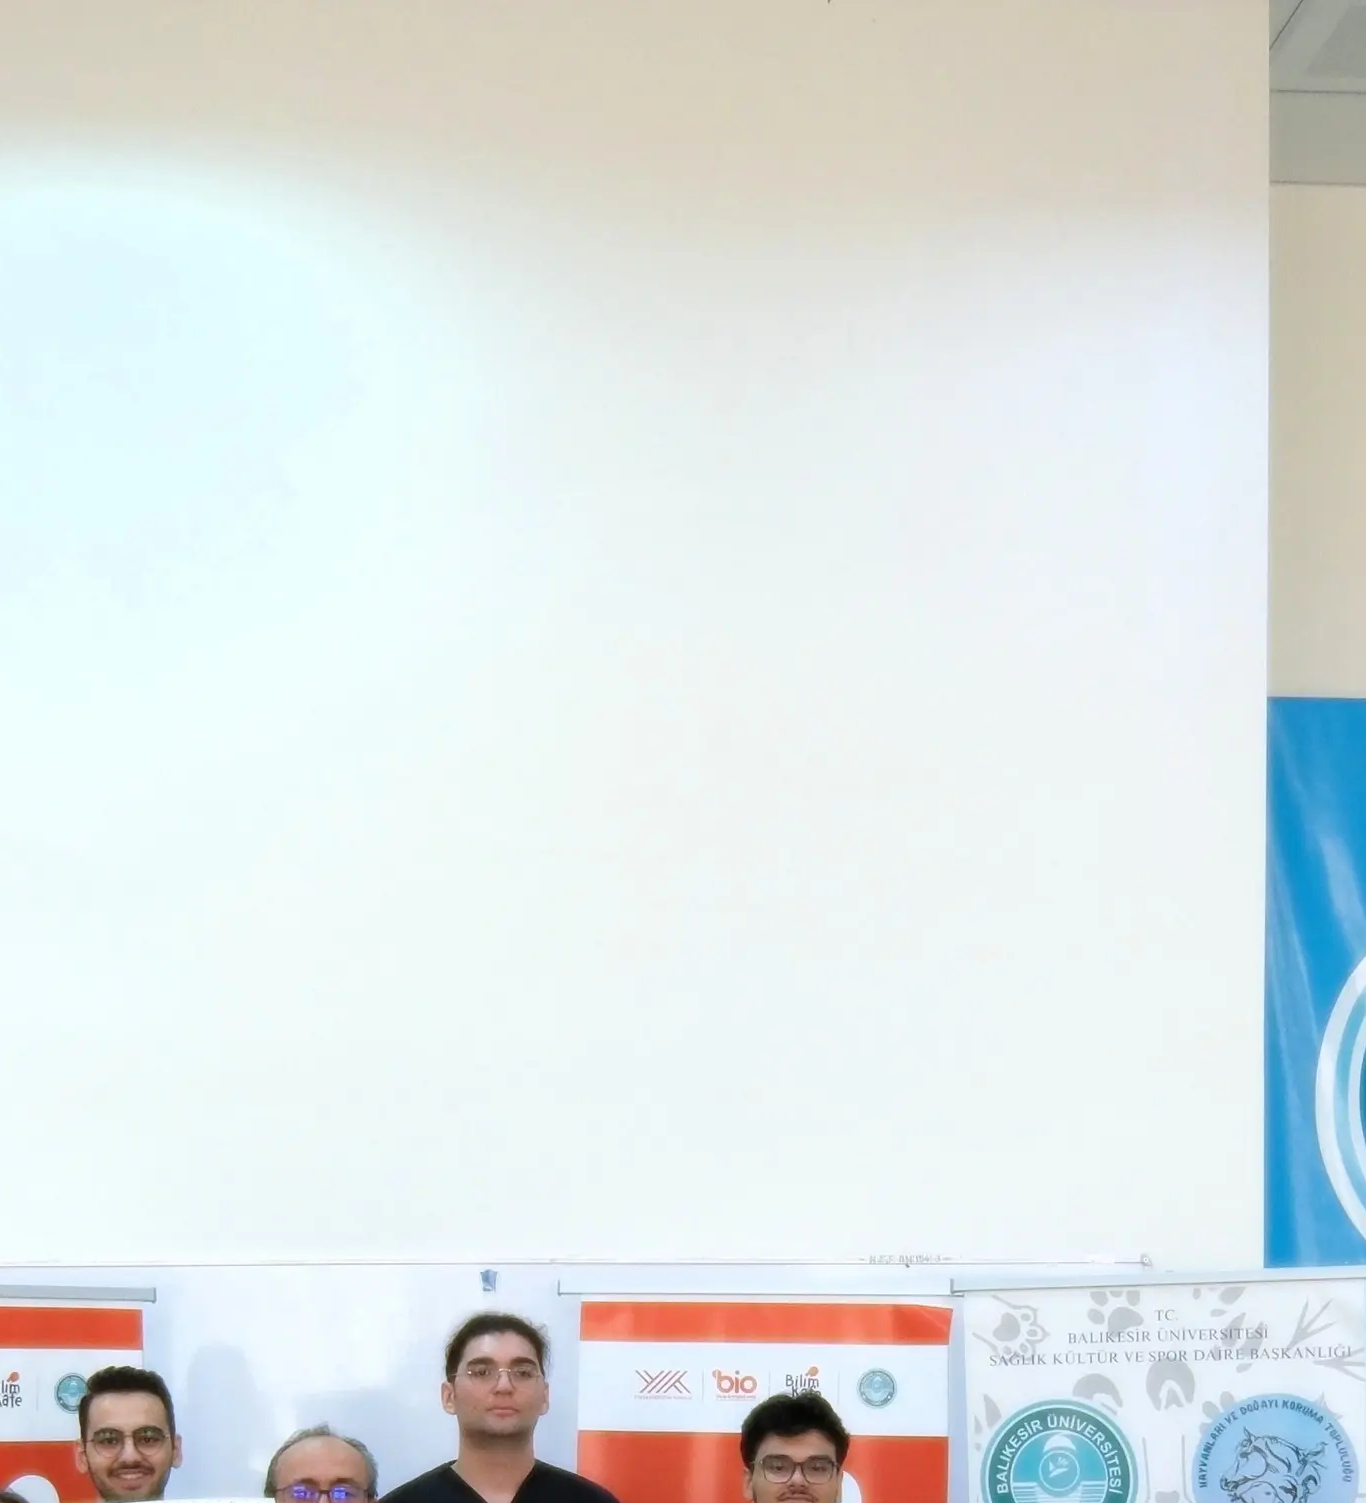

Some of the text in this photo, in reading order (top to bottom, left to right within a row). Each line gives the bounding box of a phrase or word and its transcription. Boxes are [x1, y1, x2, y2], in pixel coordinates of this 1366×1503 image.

[1068, 1327, 1151, 1344] BALIKESİR
[990, 1351, 1047, 1366] SAĞLIK
[1053, 1350, 1118, 1365] KÜLTÜR
[1124, 1352, 1144, 1363] VE
[1149, 1349, 1187, 1362] SPOR
[1250, 1344, 1352, 1363] BAŞKANLIĞI
[712, 1369, 757, 1394] bio
[785, 1373, 820, 1388] Bilim
[1199, 1399, 1354, 1488] HAYVANLARI VE DOĞAYI KORUMA TOPLULUĞU
[996, 1420, 1043, 1494] BALIKESİR
